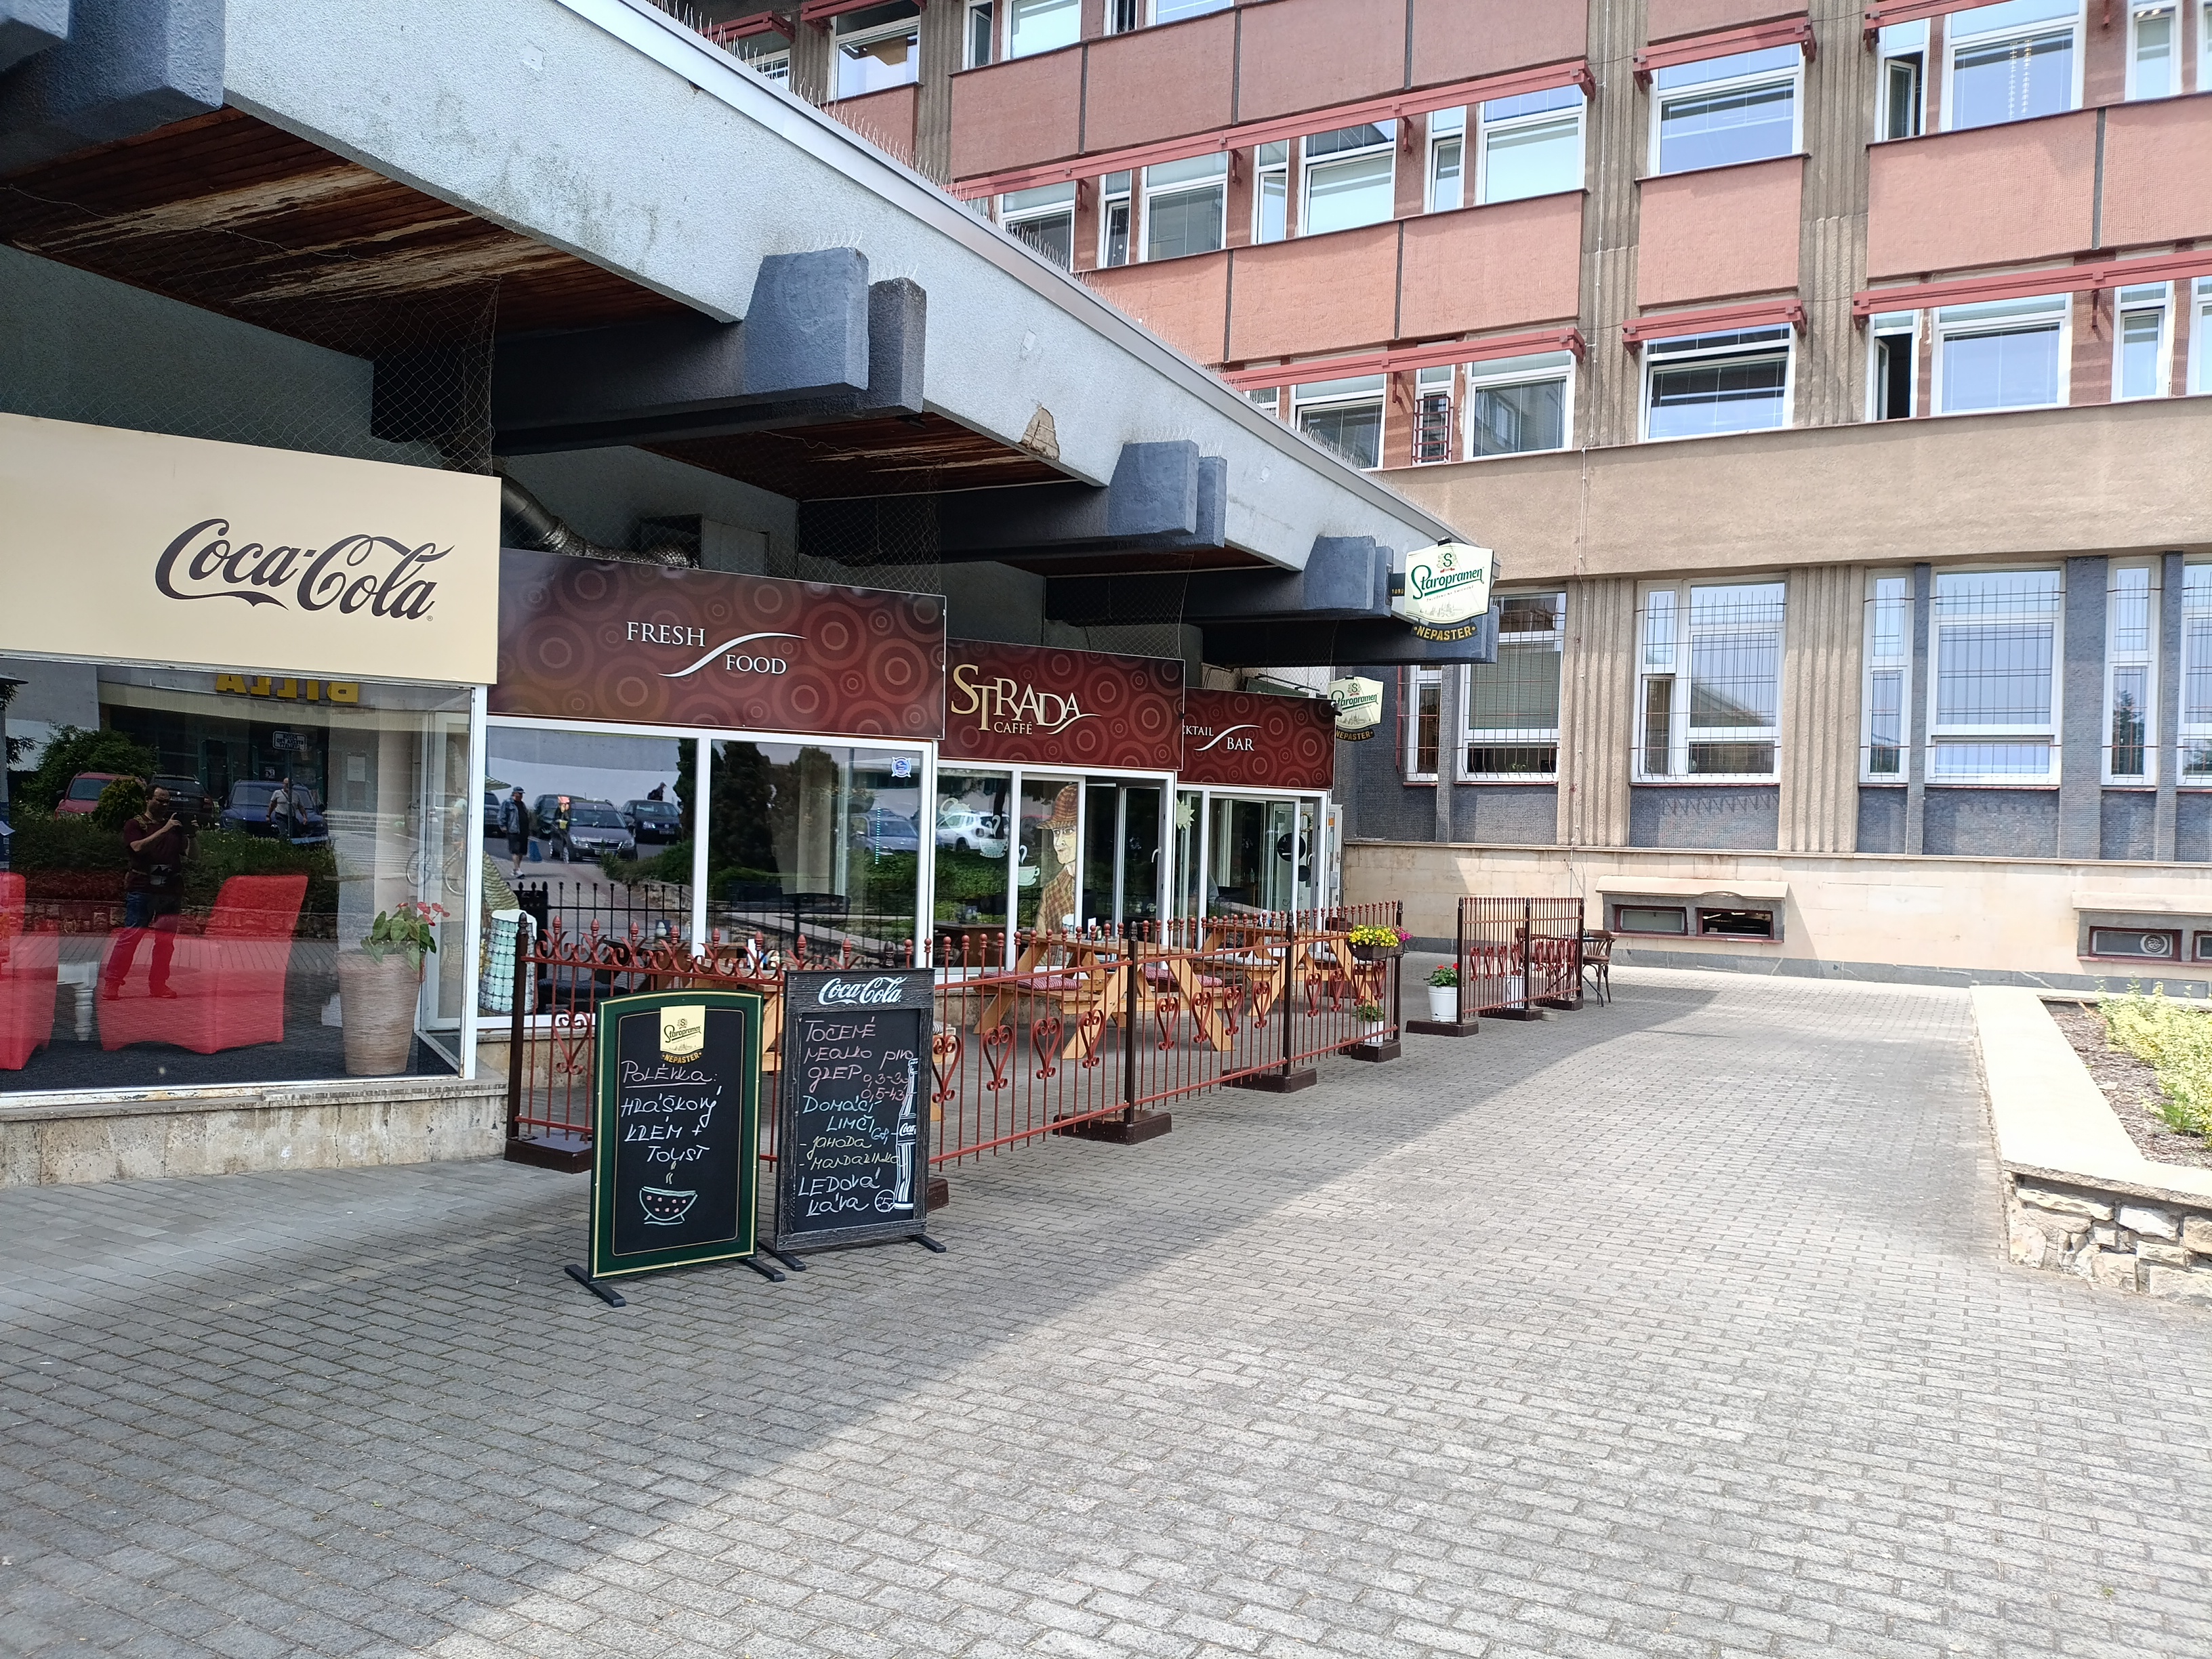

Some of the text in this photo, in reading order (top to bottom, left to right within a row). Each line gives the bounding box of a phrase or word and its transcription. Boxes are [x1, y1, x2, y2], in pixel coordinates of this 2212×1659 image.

[1411, 565, 1484, 600] Staropramen
[626, 621, 705, 647] FRESH
[1416, 626, 1472, 640] NEPASTER
[725, 654, 787, 674] FOOD
[951, 663, 1081, 731] STRADA
[994, 721, 1032, 735] CAFFÉ
[1336, 730, 1370, 741] NEPASTER
[1227, 737, 1255, 751] BAR
[818, 977, 908, 1005] Coca-Cola
[663, 1025, 702, 1043] Staropramen
[664, 1052, 700, 1063] NEPASTER
